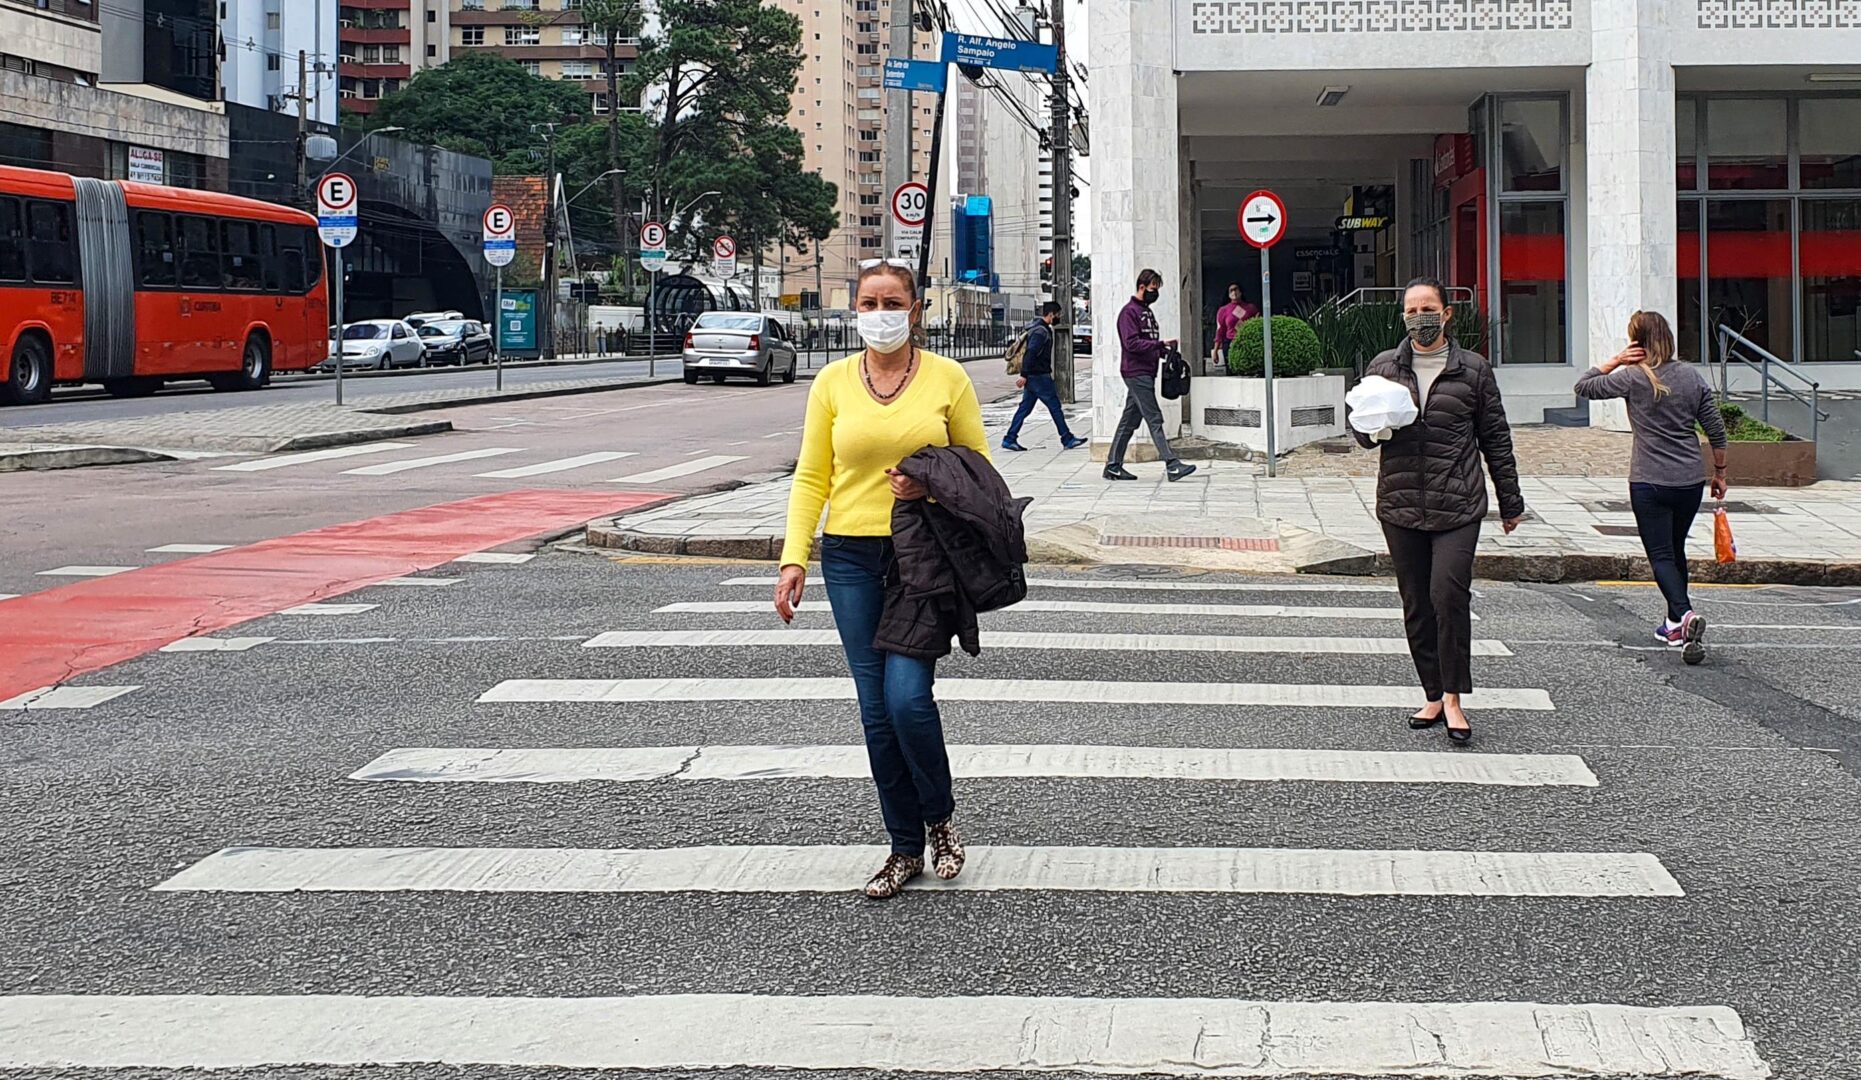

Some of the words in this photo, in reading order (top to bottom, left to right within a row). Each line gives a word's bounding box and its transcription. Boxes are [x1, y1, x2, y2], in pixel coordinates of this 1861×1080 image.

[958, 35, 967, 44] R.
[969, 37, 983, 46] Alf.
[985, 38, 1017, 50] Angelo
[957, 46, 995, 57] Sampaio
[330, 182, 343, 201] E
[901, 192, 926, 210] 30
[494, 212, 504, 228] E
[1338, 217, 1388, 229] SUBWAY
[649, 228, 658, 241] E
